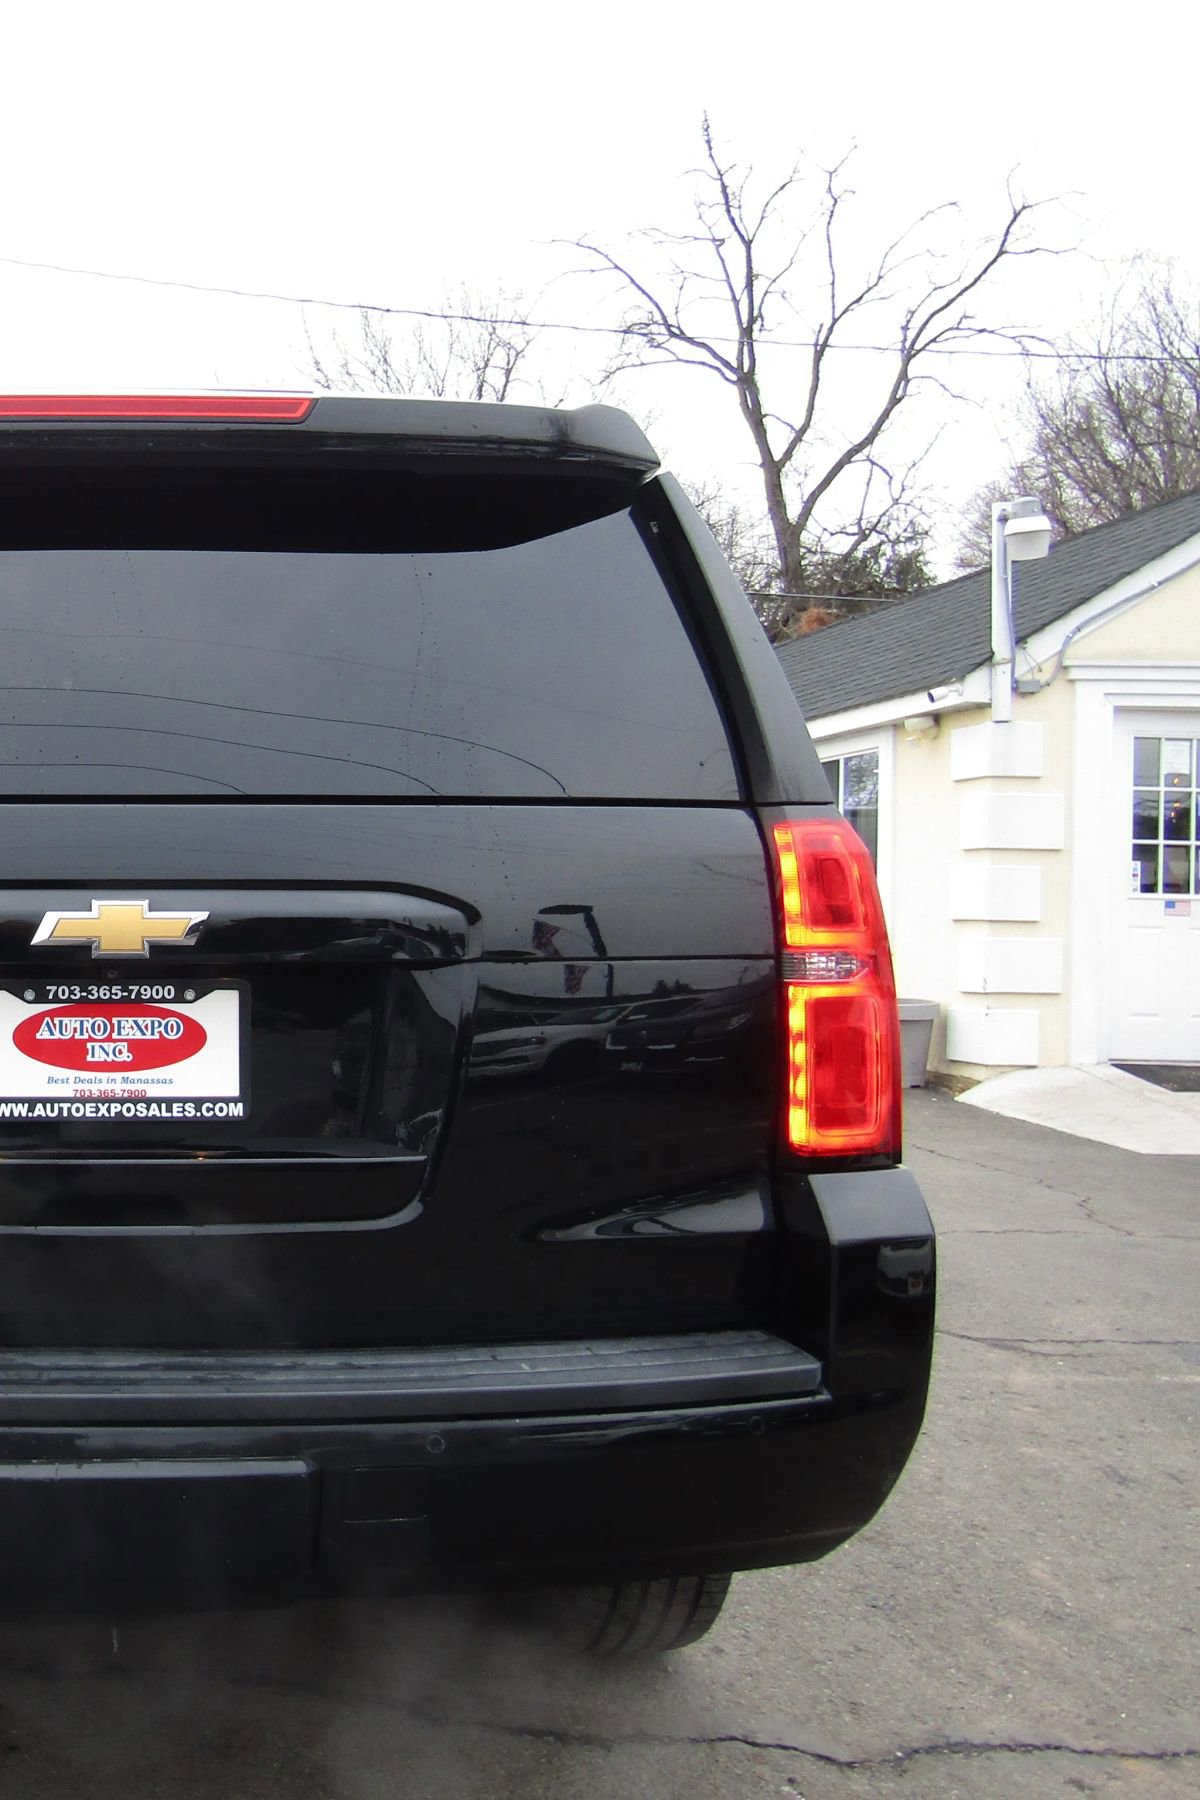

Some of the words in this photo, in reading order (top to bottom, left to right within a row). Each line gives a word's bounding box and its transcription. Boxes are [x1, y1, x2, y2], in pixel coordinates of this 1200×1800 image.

[46, 985, 175, 1000] 703-365-7900
[36, 1017, 110, 1039] AUTO
[112, 1017, 183, 1040] EXPO
[86, 1042, 133, 1061] INC.
[47, 1076, 69, 1085] Best
[73, 1076, 103, 1085] Deals
[106, 1076, 117, 1085] in
[120, 1076, 174, 1085] Manassas
[72, 1089, 147, 1098] 703-365-7900
